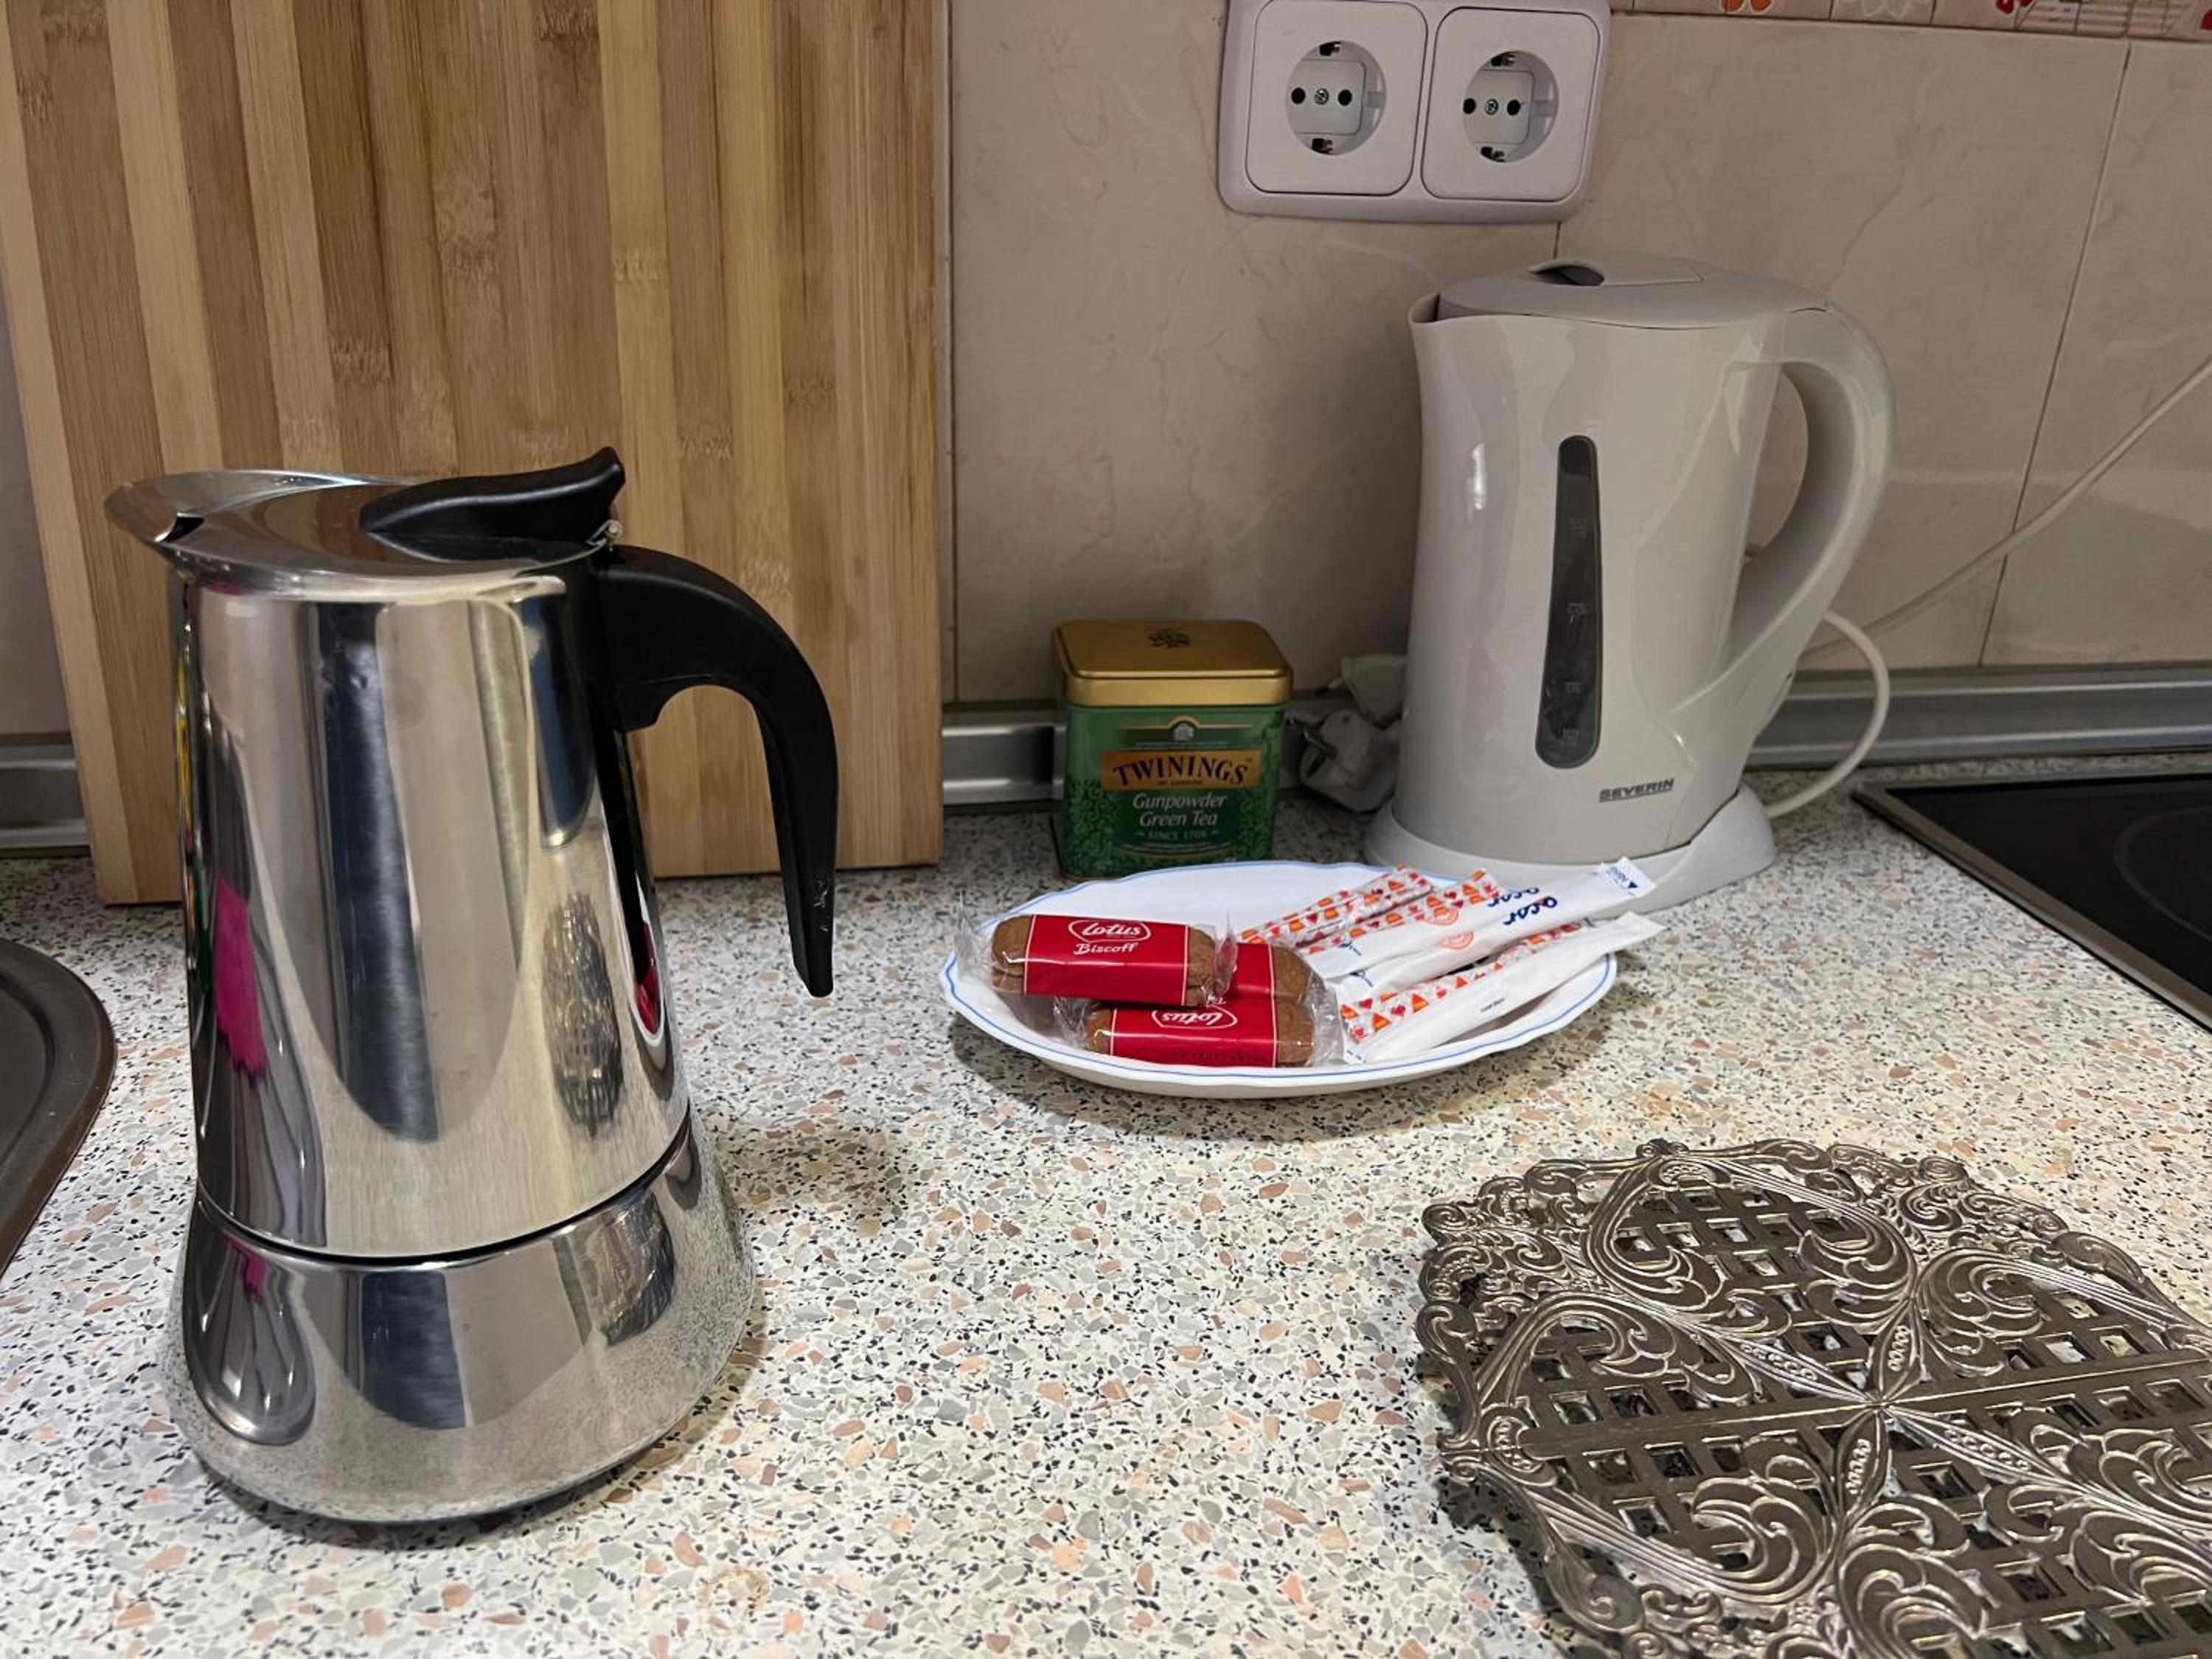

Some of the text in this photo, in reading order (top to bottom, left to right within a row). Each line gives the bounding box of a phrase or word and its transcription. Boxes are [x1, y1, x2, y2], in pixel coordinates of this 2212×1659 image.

[1112, 755, 1248, 787] TWININGS
[1599, 778, 1674, 801] SEVERIN
[1133, 791, 1228, 811] Gunpowder
[1139, 810, 1219, 827] Green Tea
[1081, 922, 1141, 936] Lotus
[1073, 942, 1140, 956] Biscoff
[1161, 1012, 1224, 1026] Lotus
